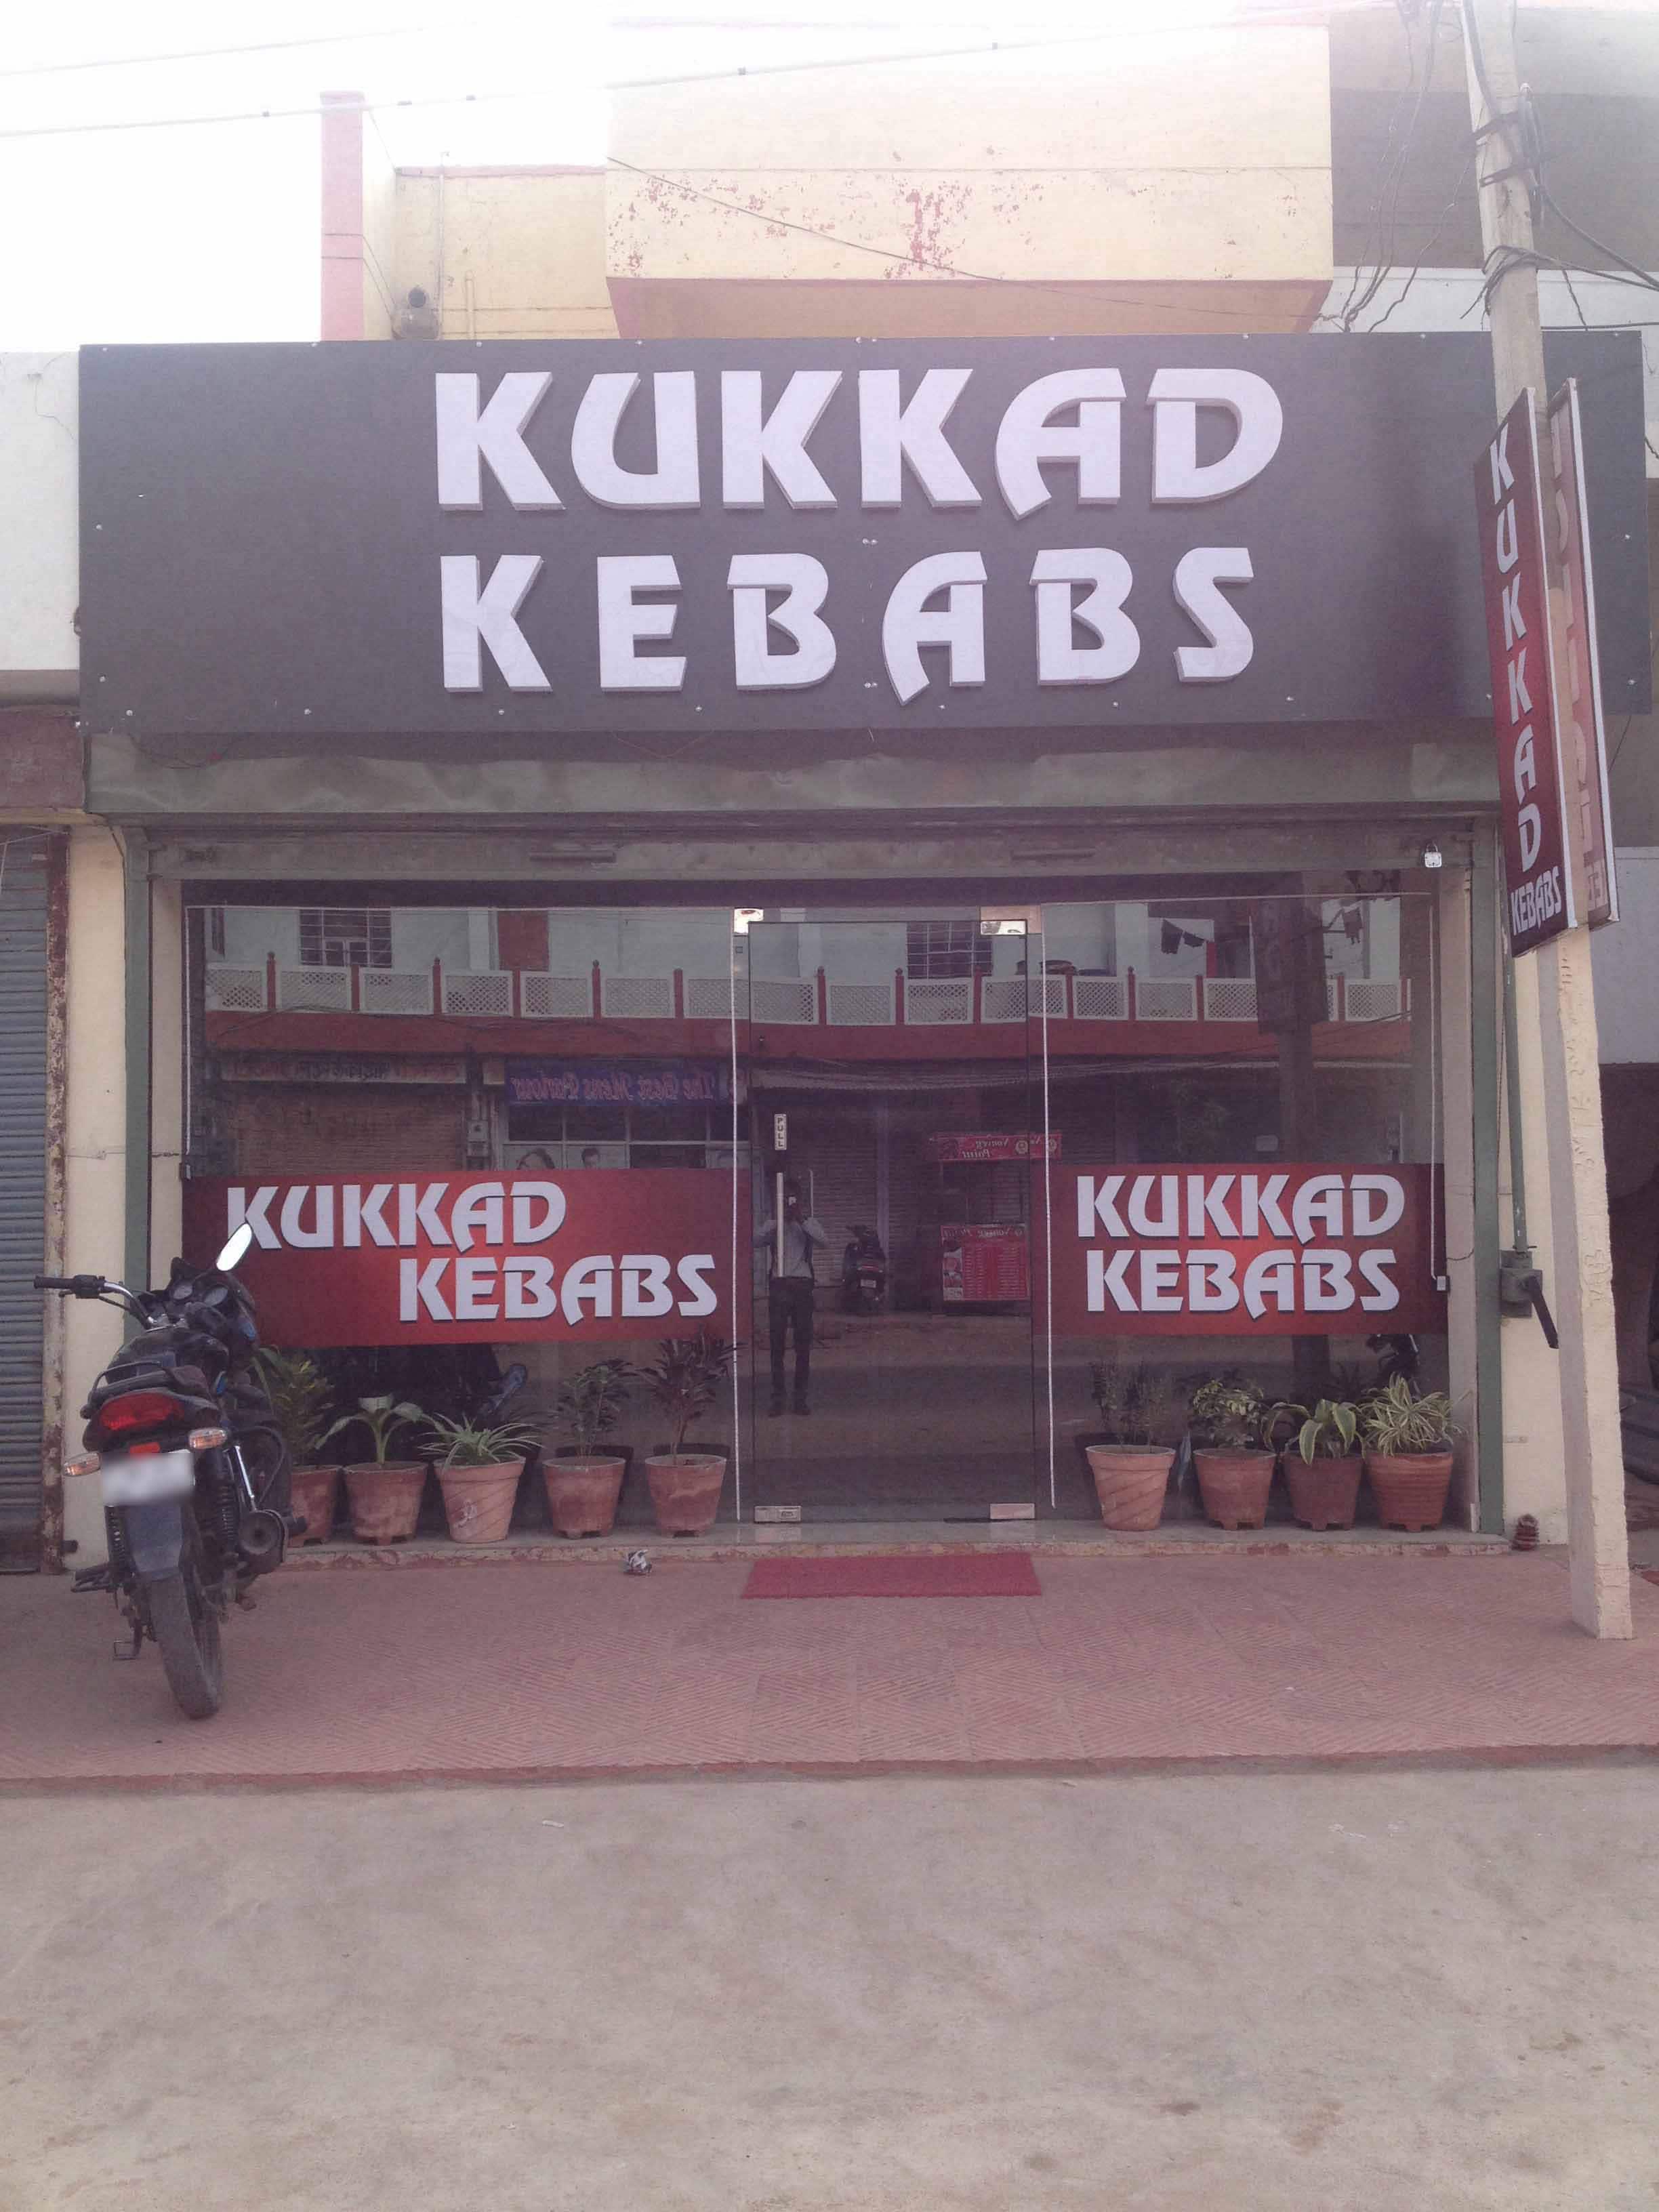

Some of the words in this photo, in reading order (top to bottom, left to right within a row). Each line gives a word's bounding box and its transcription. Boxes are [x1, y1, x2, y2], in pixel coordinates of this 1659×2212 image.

[435, 368, 1284, 520] KUKKAD
[440, 547, 1254, 705] KEBABS
[1490, 422, 1540, 873] KUKKAD
[1511, 865, 1562, 936] KEBABS
[227, 1181, 567, 1253] KUKKAD
[1077, 1174, 1405, 1245] KUKKAD
[400, 1254, 718, 1326] KEBABS
[1086, 1249, 1399, 1320] KEBABS
